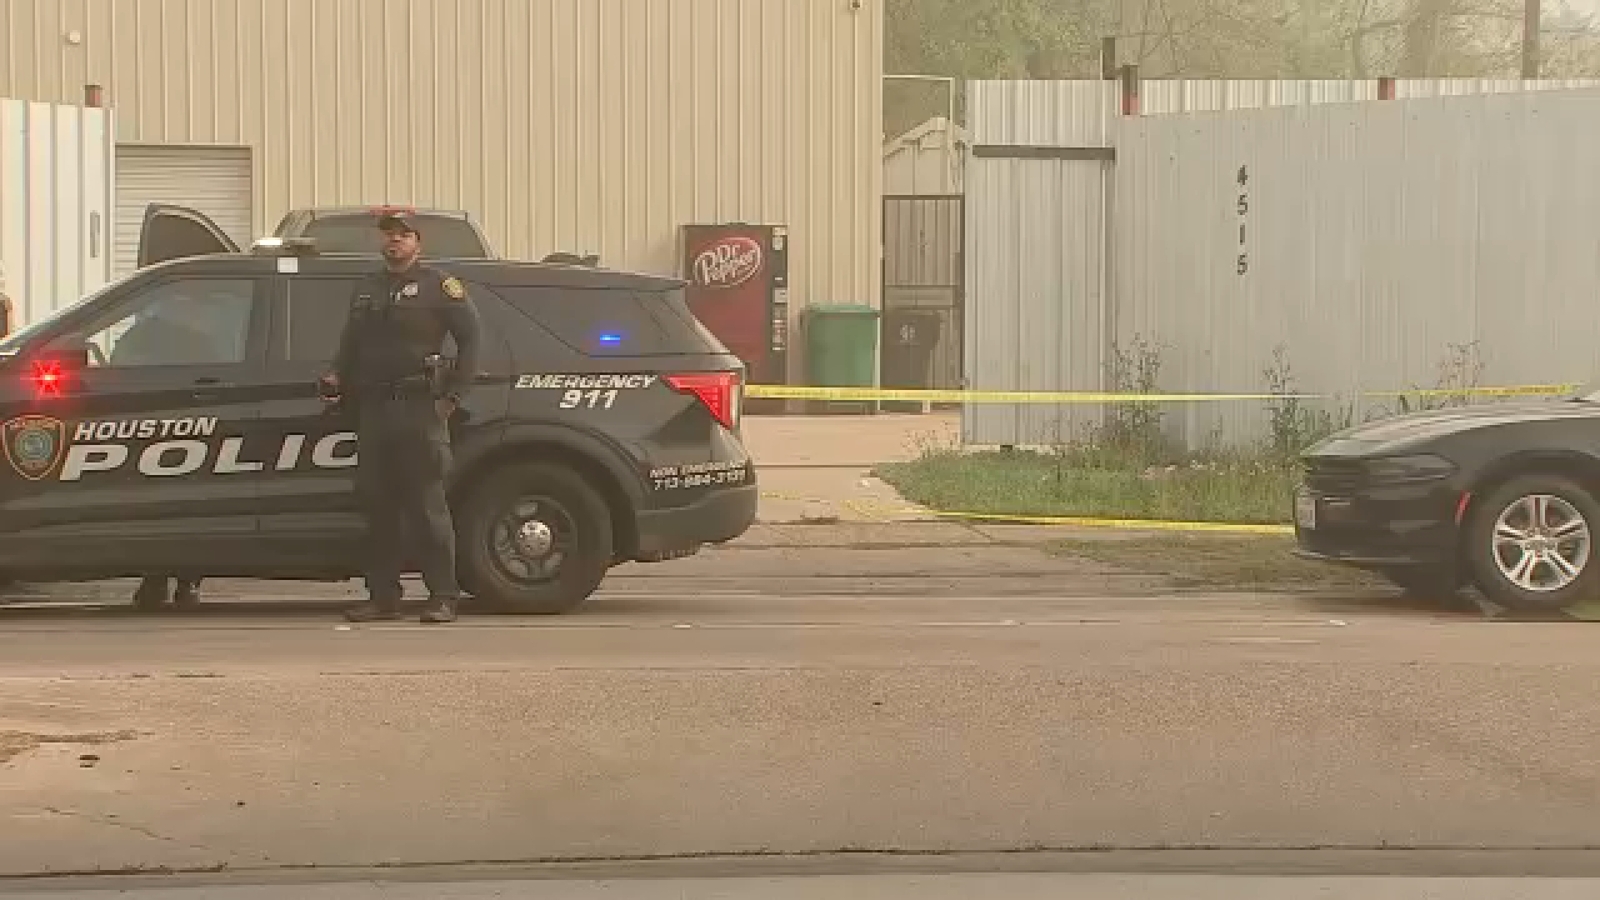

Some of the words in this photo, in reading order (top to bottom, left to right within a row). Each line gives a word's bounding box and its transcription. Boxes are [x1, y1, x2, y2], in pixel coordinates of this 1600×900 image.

[1237, 164, 1248, 275] 4515
[695, 248, 757, 286] Pepper
[515, 374, 658, 389] EMERGENCY
[559, 389, 618, 409] 911
[73, 417, 218, 442] HOUSTON
[60, 432, 359, 482] POLIC
